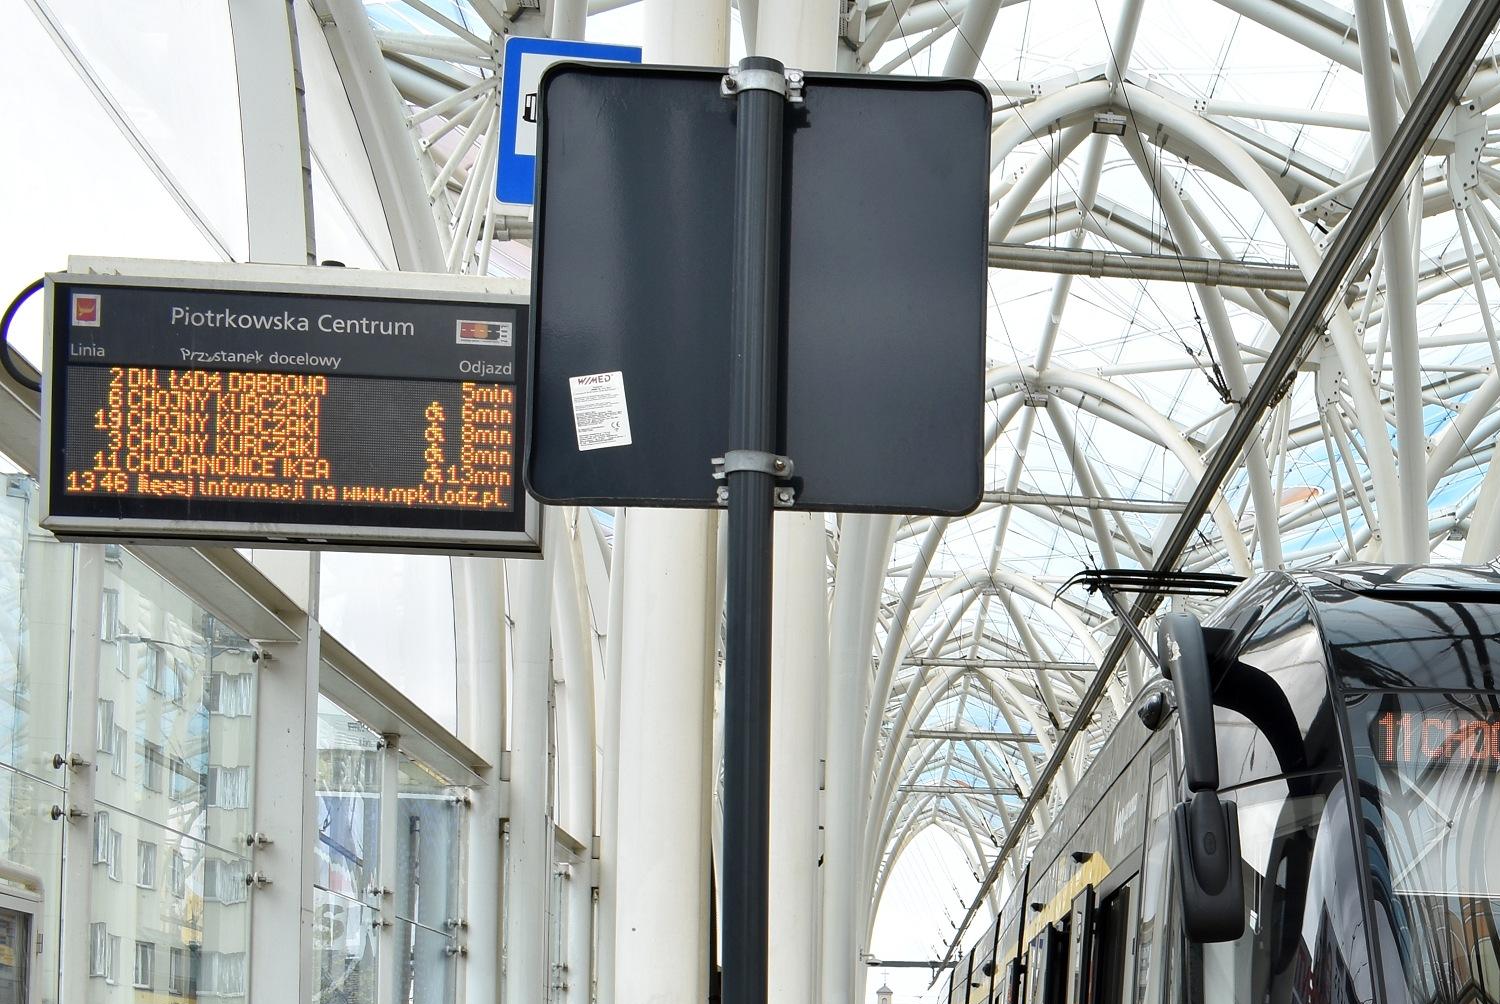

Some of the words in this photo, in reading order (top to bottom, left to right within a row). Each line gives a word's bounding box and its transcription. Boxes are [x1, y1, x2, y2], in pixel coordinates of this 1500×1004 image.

[171, 306, 309, 332] Piotrkowska
[317, 314, 415, 336] Centrum
[70, 342, 106, 357] Linia
[268, 351, 342, 369] docelowy
[459, 360, 513, 377] Odjazd
[110, 368, 123, 387] 2
[462, 382, 513, 403] 5min
[128, 389, 210, 412] CHOJNY
[217, 392, 319, 416] KURCZAKI
[94, 408, 123, 429] 19
[127, 410, 209, 433] CHOJNY
[216, 413, 319, 437] KURCZAKI
[108, 430, 123, 450] 3
[126, 431, 208, 454] CHOJNY
[216, 434, 319, 458] KURCZAKI
[93, 451, 121, 470] 11
[126, 452, 276, 477] CHOCIANOWICE
[283, 457, 330, 479] IKEA
[447, 465, 512, 486] 13min
[199, 476, 305, 500] informacji
[313, 485, 336, 500] na
[1378, 712, 1412, 762] 11
